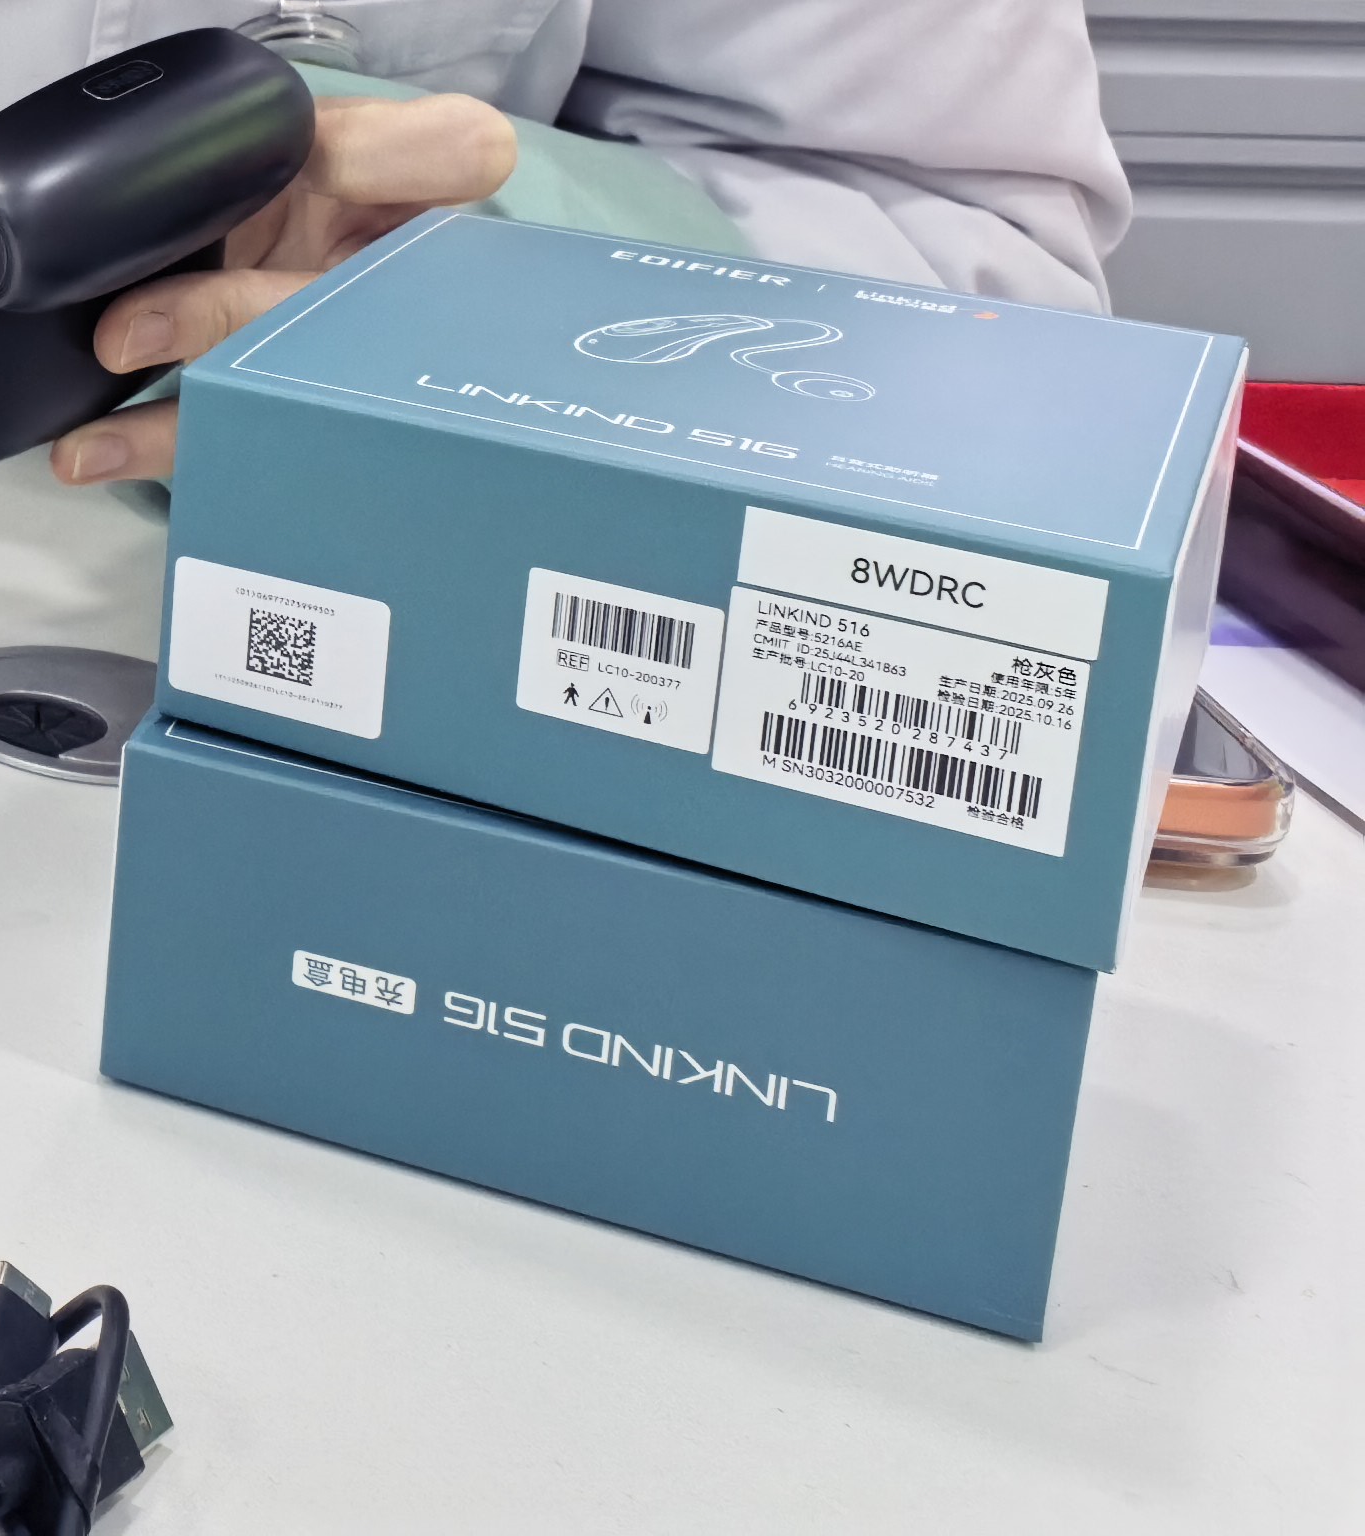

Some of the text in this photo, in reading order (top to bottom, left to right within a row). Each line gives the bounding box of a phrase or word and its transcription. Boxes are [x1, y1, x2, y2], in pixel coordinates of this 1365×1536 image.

[611, 250, 791, 287] EDIFIER
[416, 373, 801, 460] LINKIND 516
[850, 556, 987, 609] 8WDRC
[757, 600, 871, 638] LINKIND 516
[557, 650, 590, 670] REF
[753, 633, 789, 651] CMIIT
[1011, 656, 1077, 688] 枪灰色
[762, 754, 777, 769] M
[302, 956, 405, 1008] 充电盒
[443, 990, 838, 1123] LINKIND 516
